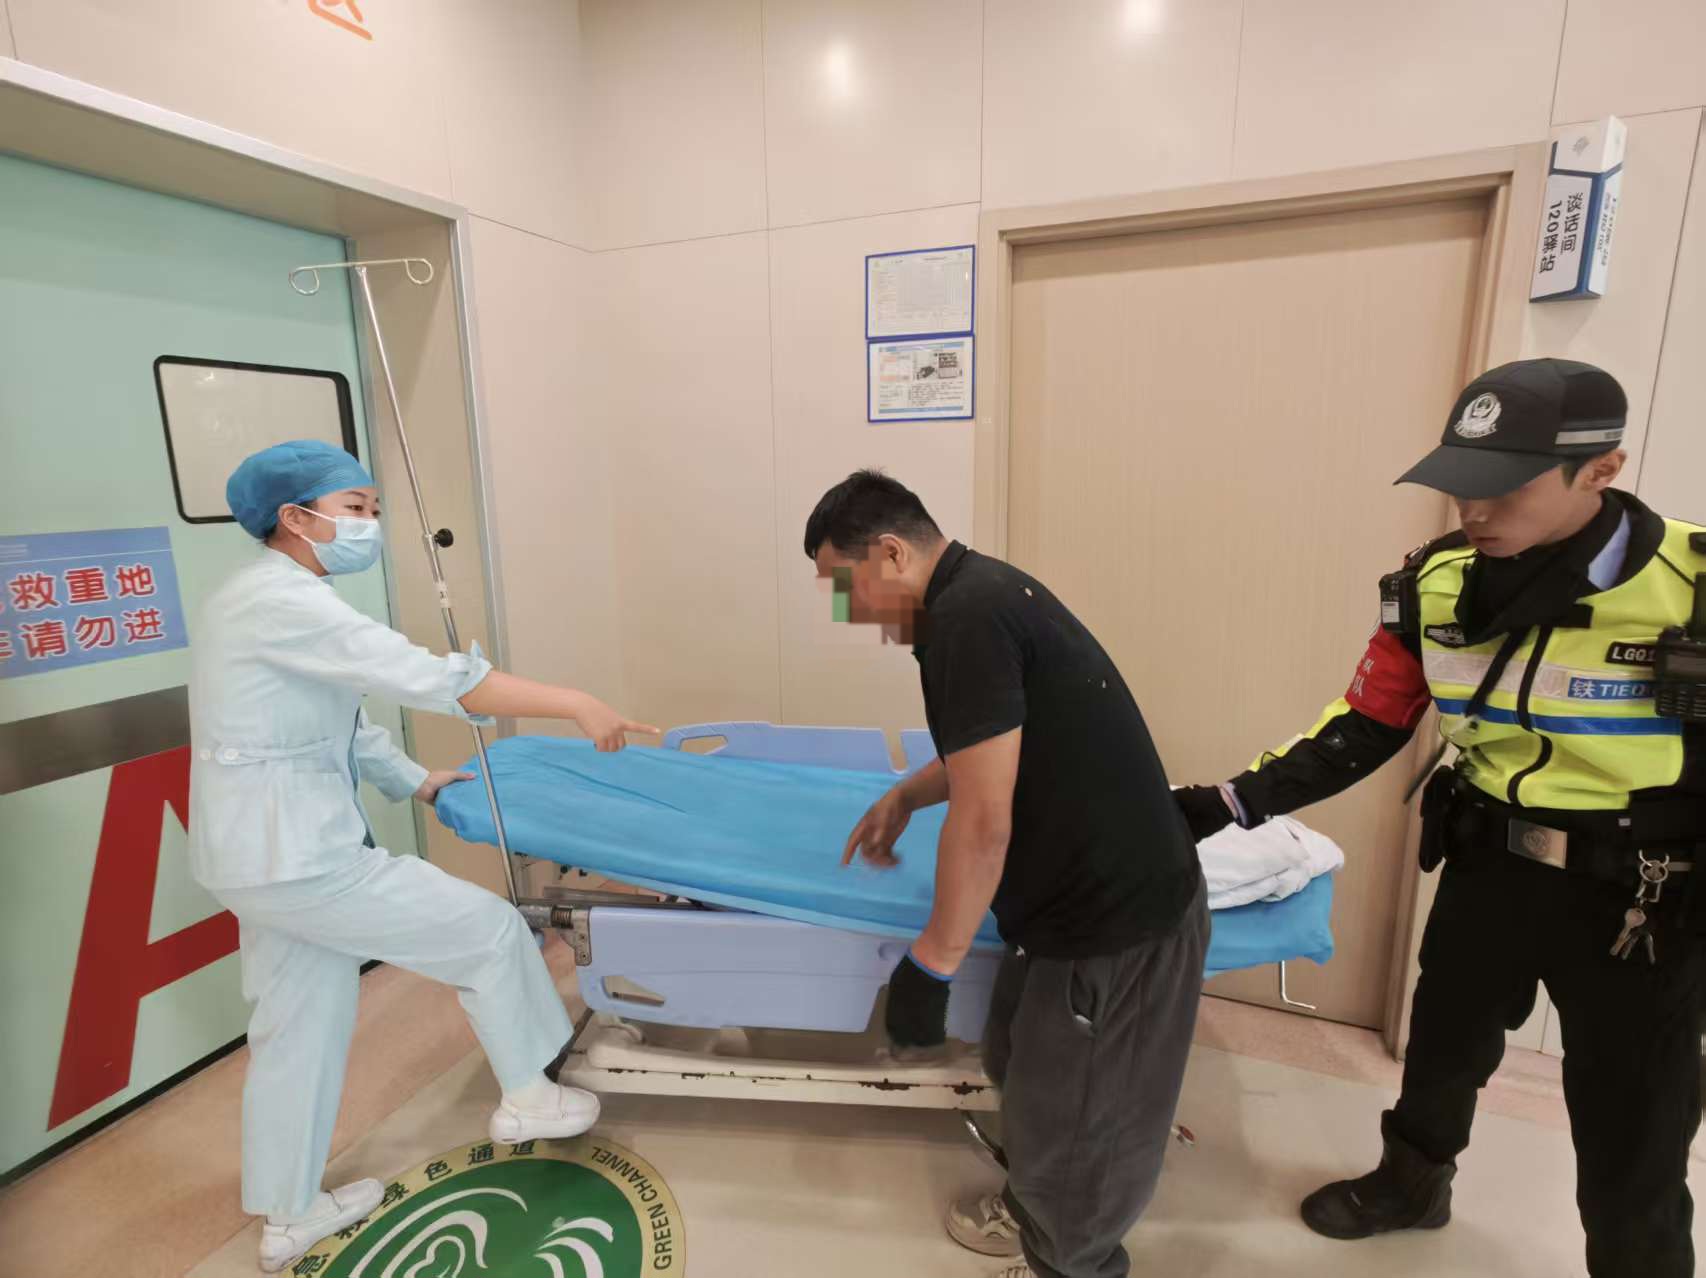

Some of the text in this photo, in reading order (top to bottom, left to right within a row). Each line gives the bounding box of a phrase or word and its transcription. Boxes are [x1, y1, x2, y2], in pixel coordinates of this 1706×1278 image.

[0, 565, 155, 613] 救重地
[1571, 680, 1596, 698] 铁
[292, 1140, 536, 1278] 急绿色通道
[591, 1146, 672, 1270] GREEN CHANNEL
